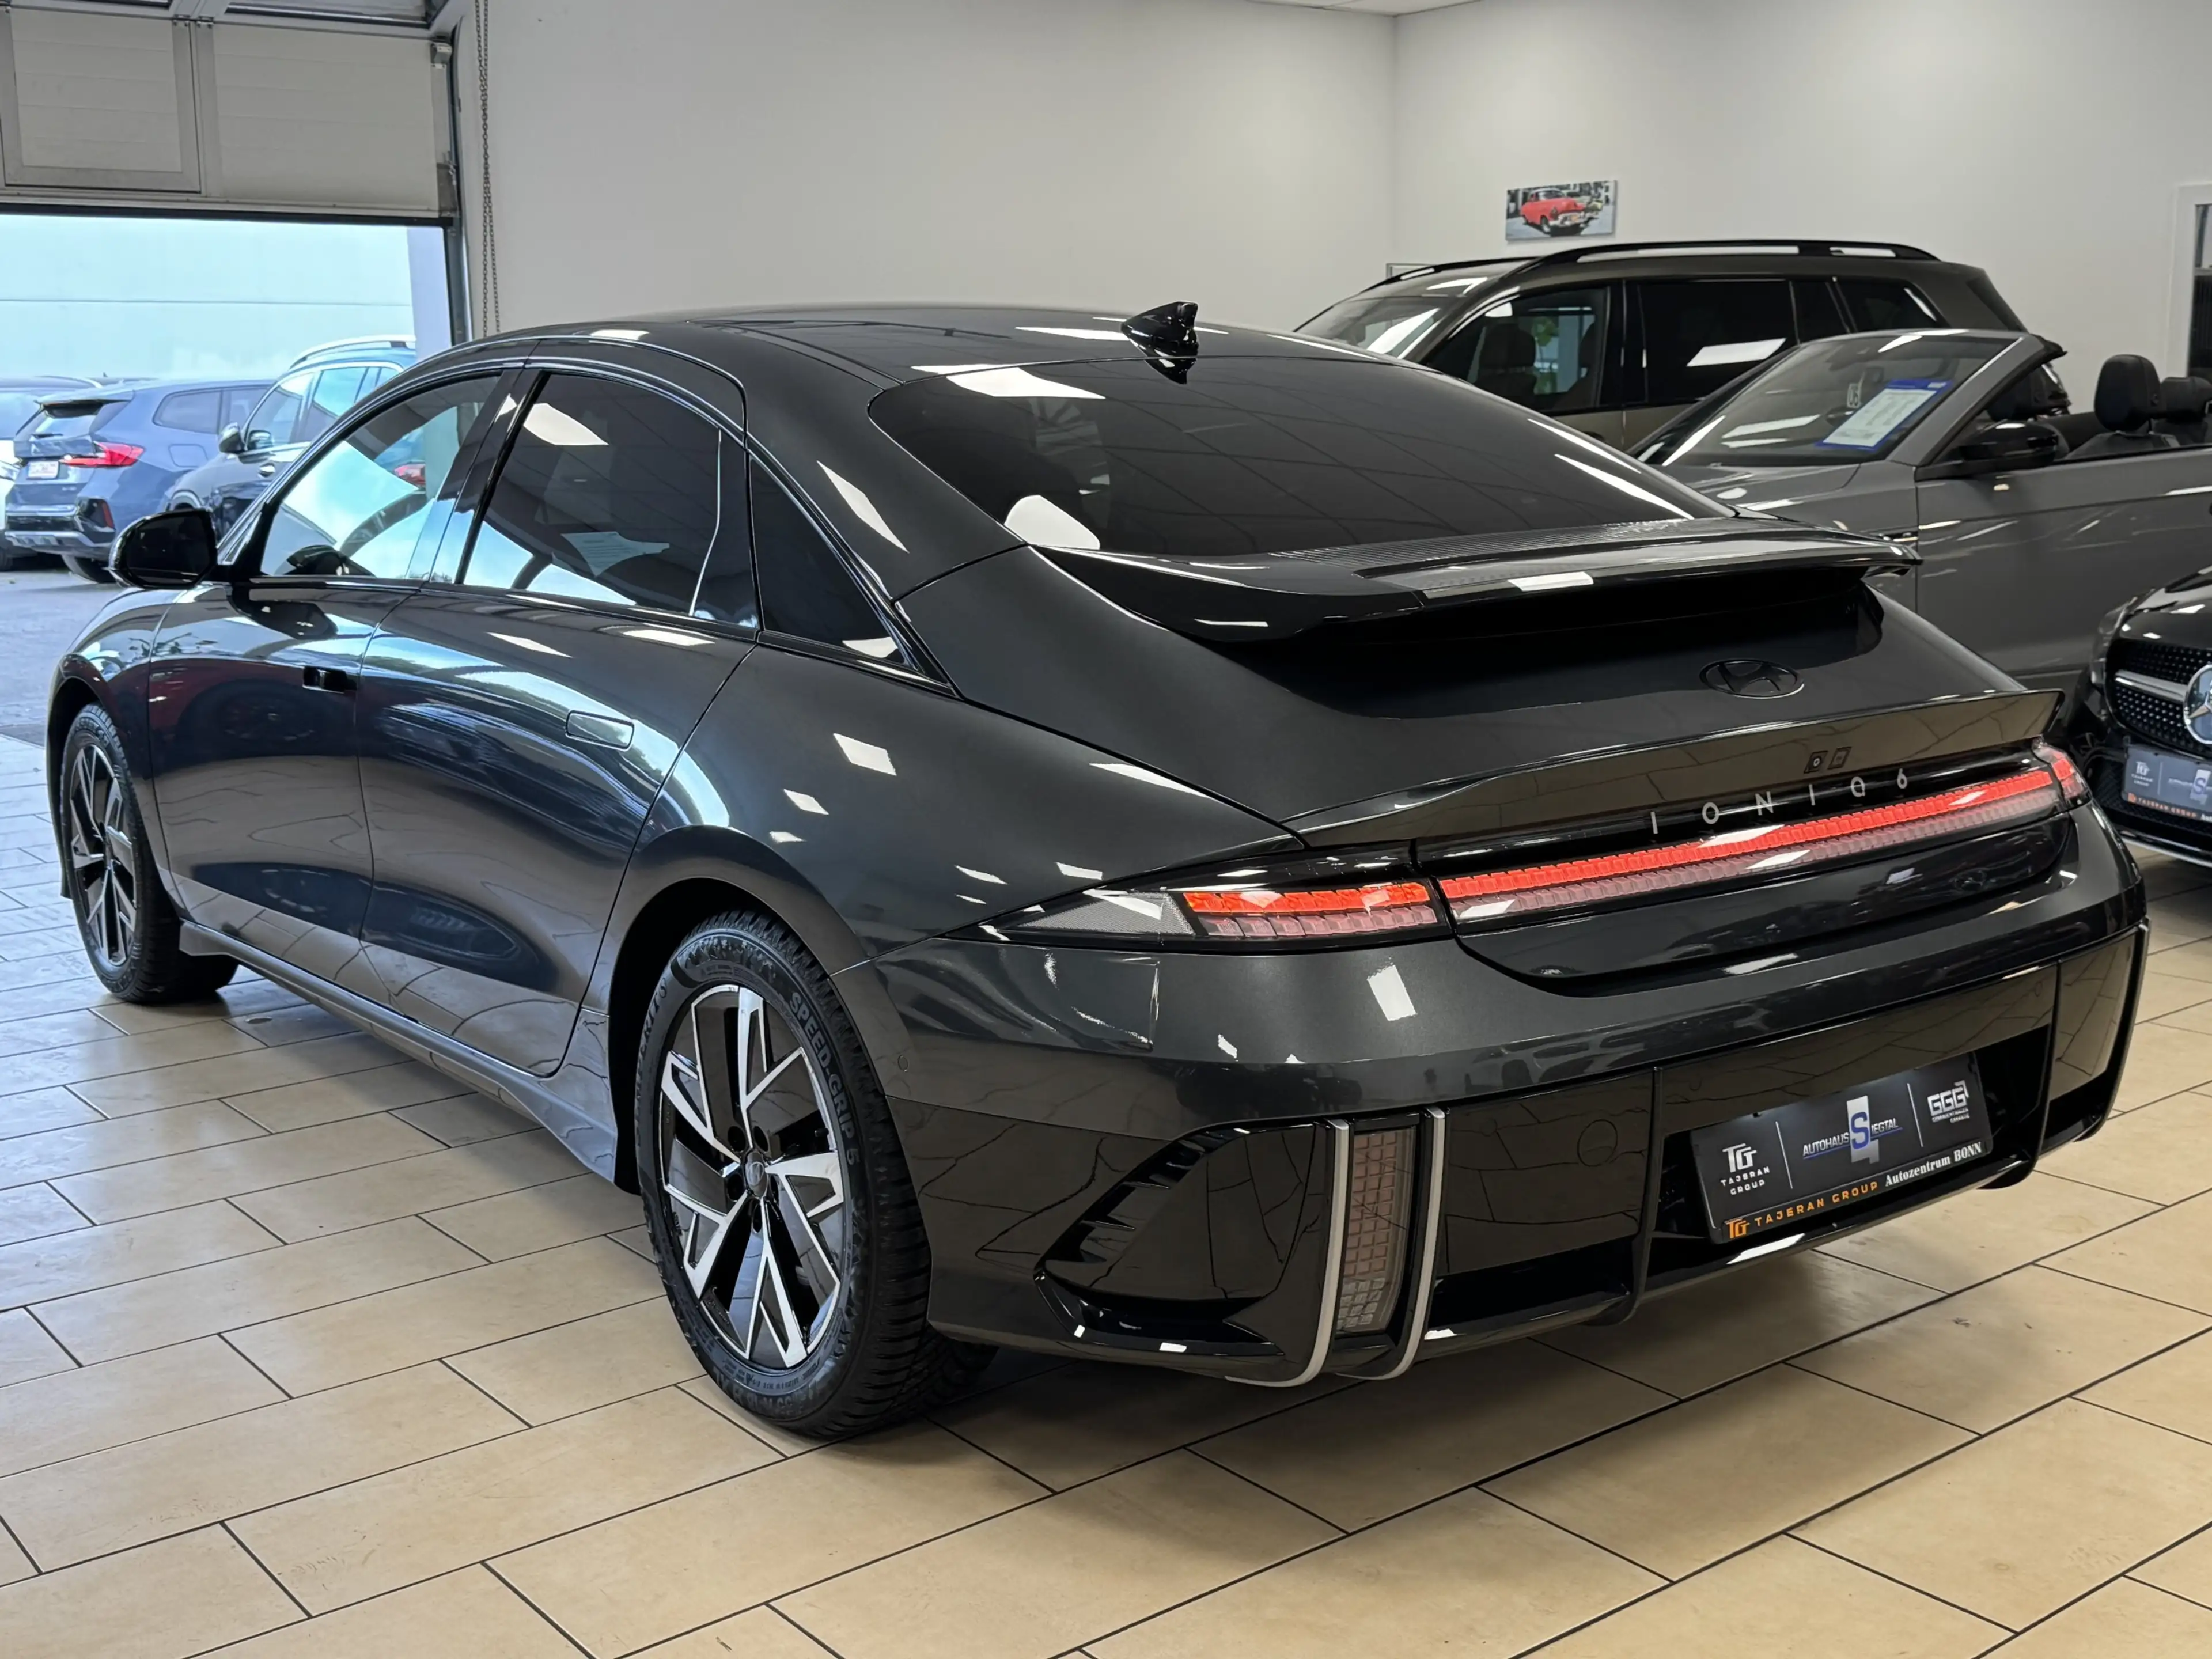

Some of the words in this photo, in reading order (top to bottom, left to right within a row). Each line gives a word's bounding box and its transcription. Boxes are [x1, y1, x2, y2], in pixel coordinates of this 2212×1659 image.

[789, 991, 857, 1139] SPEED-GRIP
[1802, 1132, 1850, 1157] AUTOHAUS
[1721, 1166, 1770, 1187] TAJERAN
[1730, 1179, 1765, 1195] GROUP
[1754, 1198, 1824, 1226] TAJERAN
[1831, 1181, 1878, 1203] GROUP
[1885, 1155, 1951, 1187] Autozentrum
[1953, 1141, 1982, 1162] BONN
